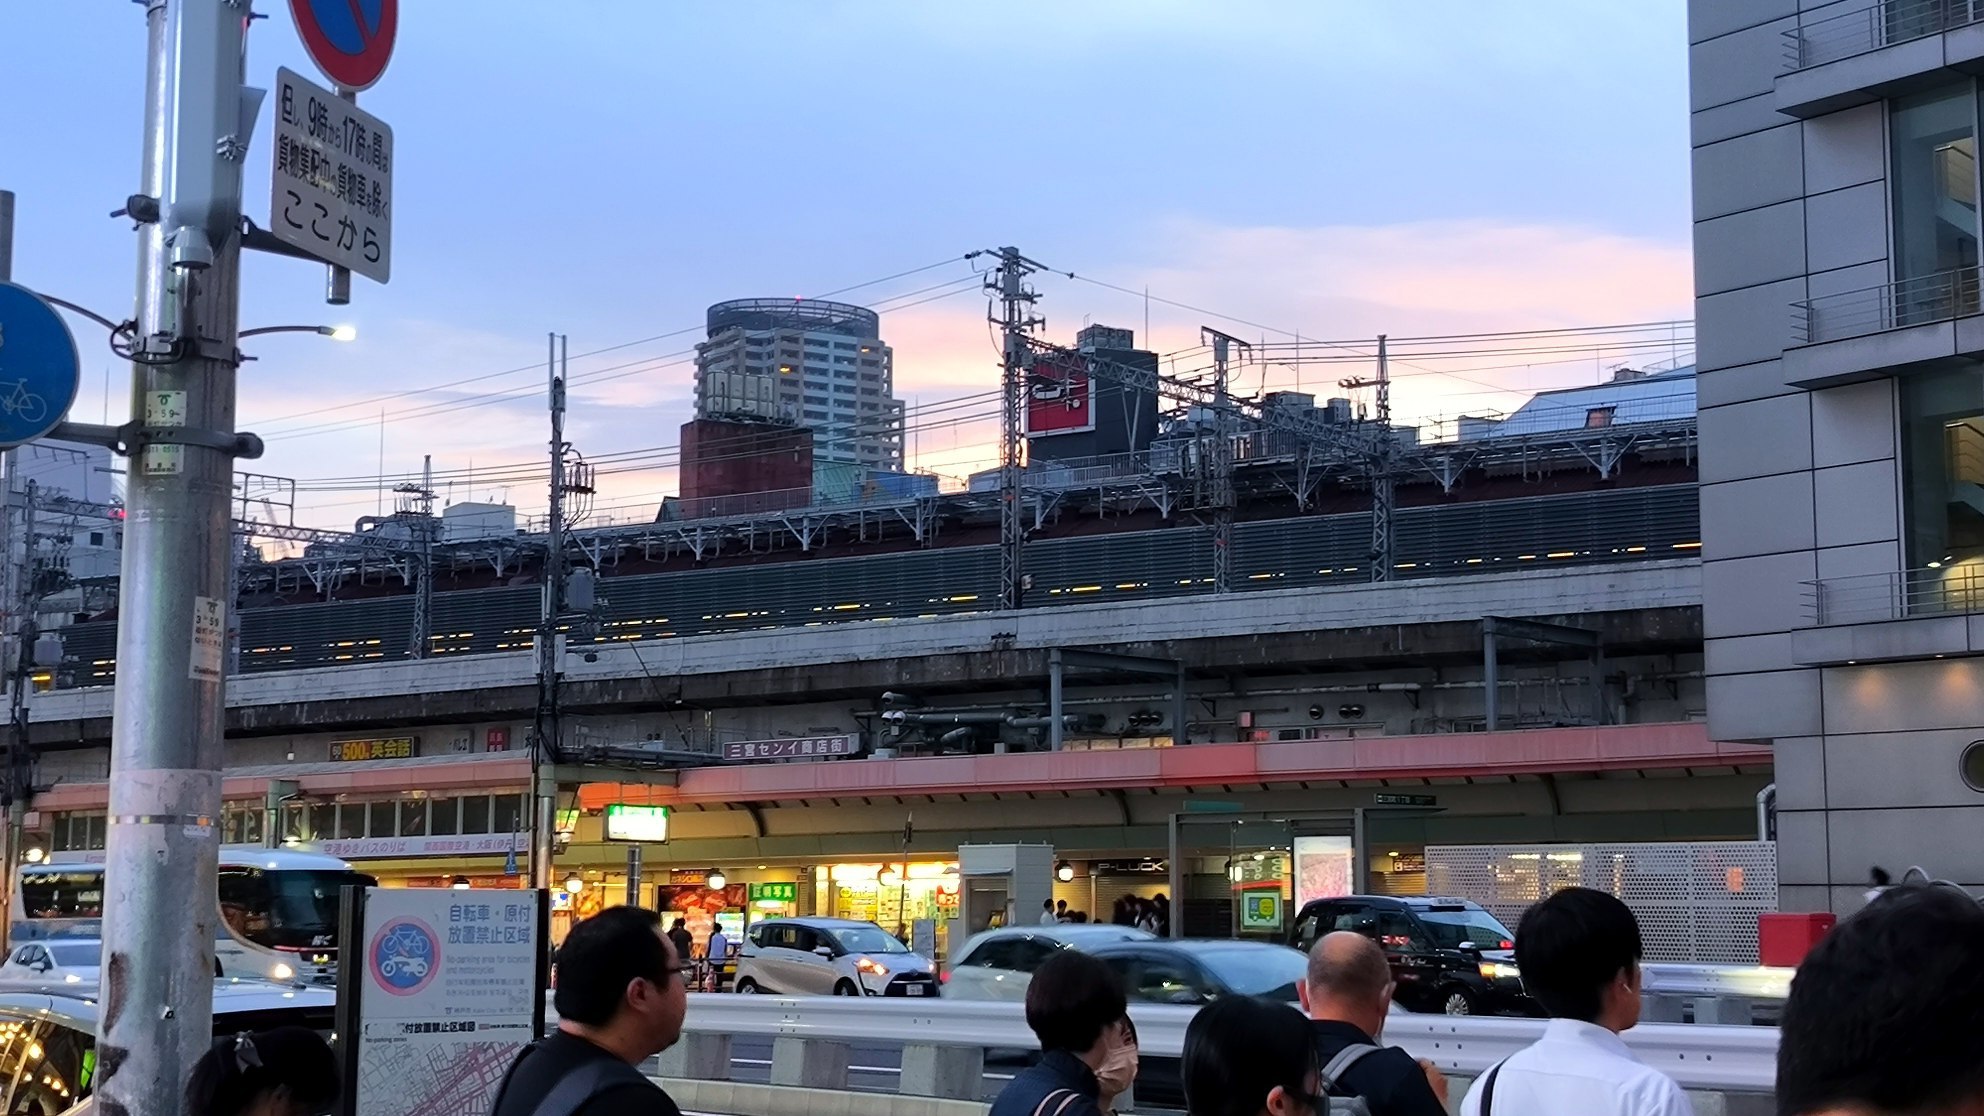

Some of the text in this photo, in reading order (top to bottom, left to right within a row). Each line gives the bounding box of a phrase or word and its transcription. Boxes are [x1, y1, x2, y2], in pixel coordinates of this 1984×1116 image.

[284, 189, 381, 264] ここから
[371, 739, 411, 758] 英会話
[730, 738, 843, 758] 三宮センイ商店街
[324, 840, 408, 856] 空港ゆきバスのりば
[1097, 861, 1166, 872] P-LUCK
[752, 885, 793, 898] 証明写真
[449, 903, 531, 924] 自転車・原付
[447, 926, 531, 946] 放置禁止区域
